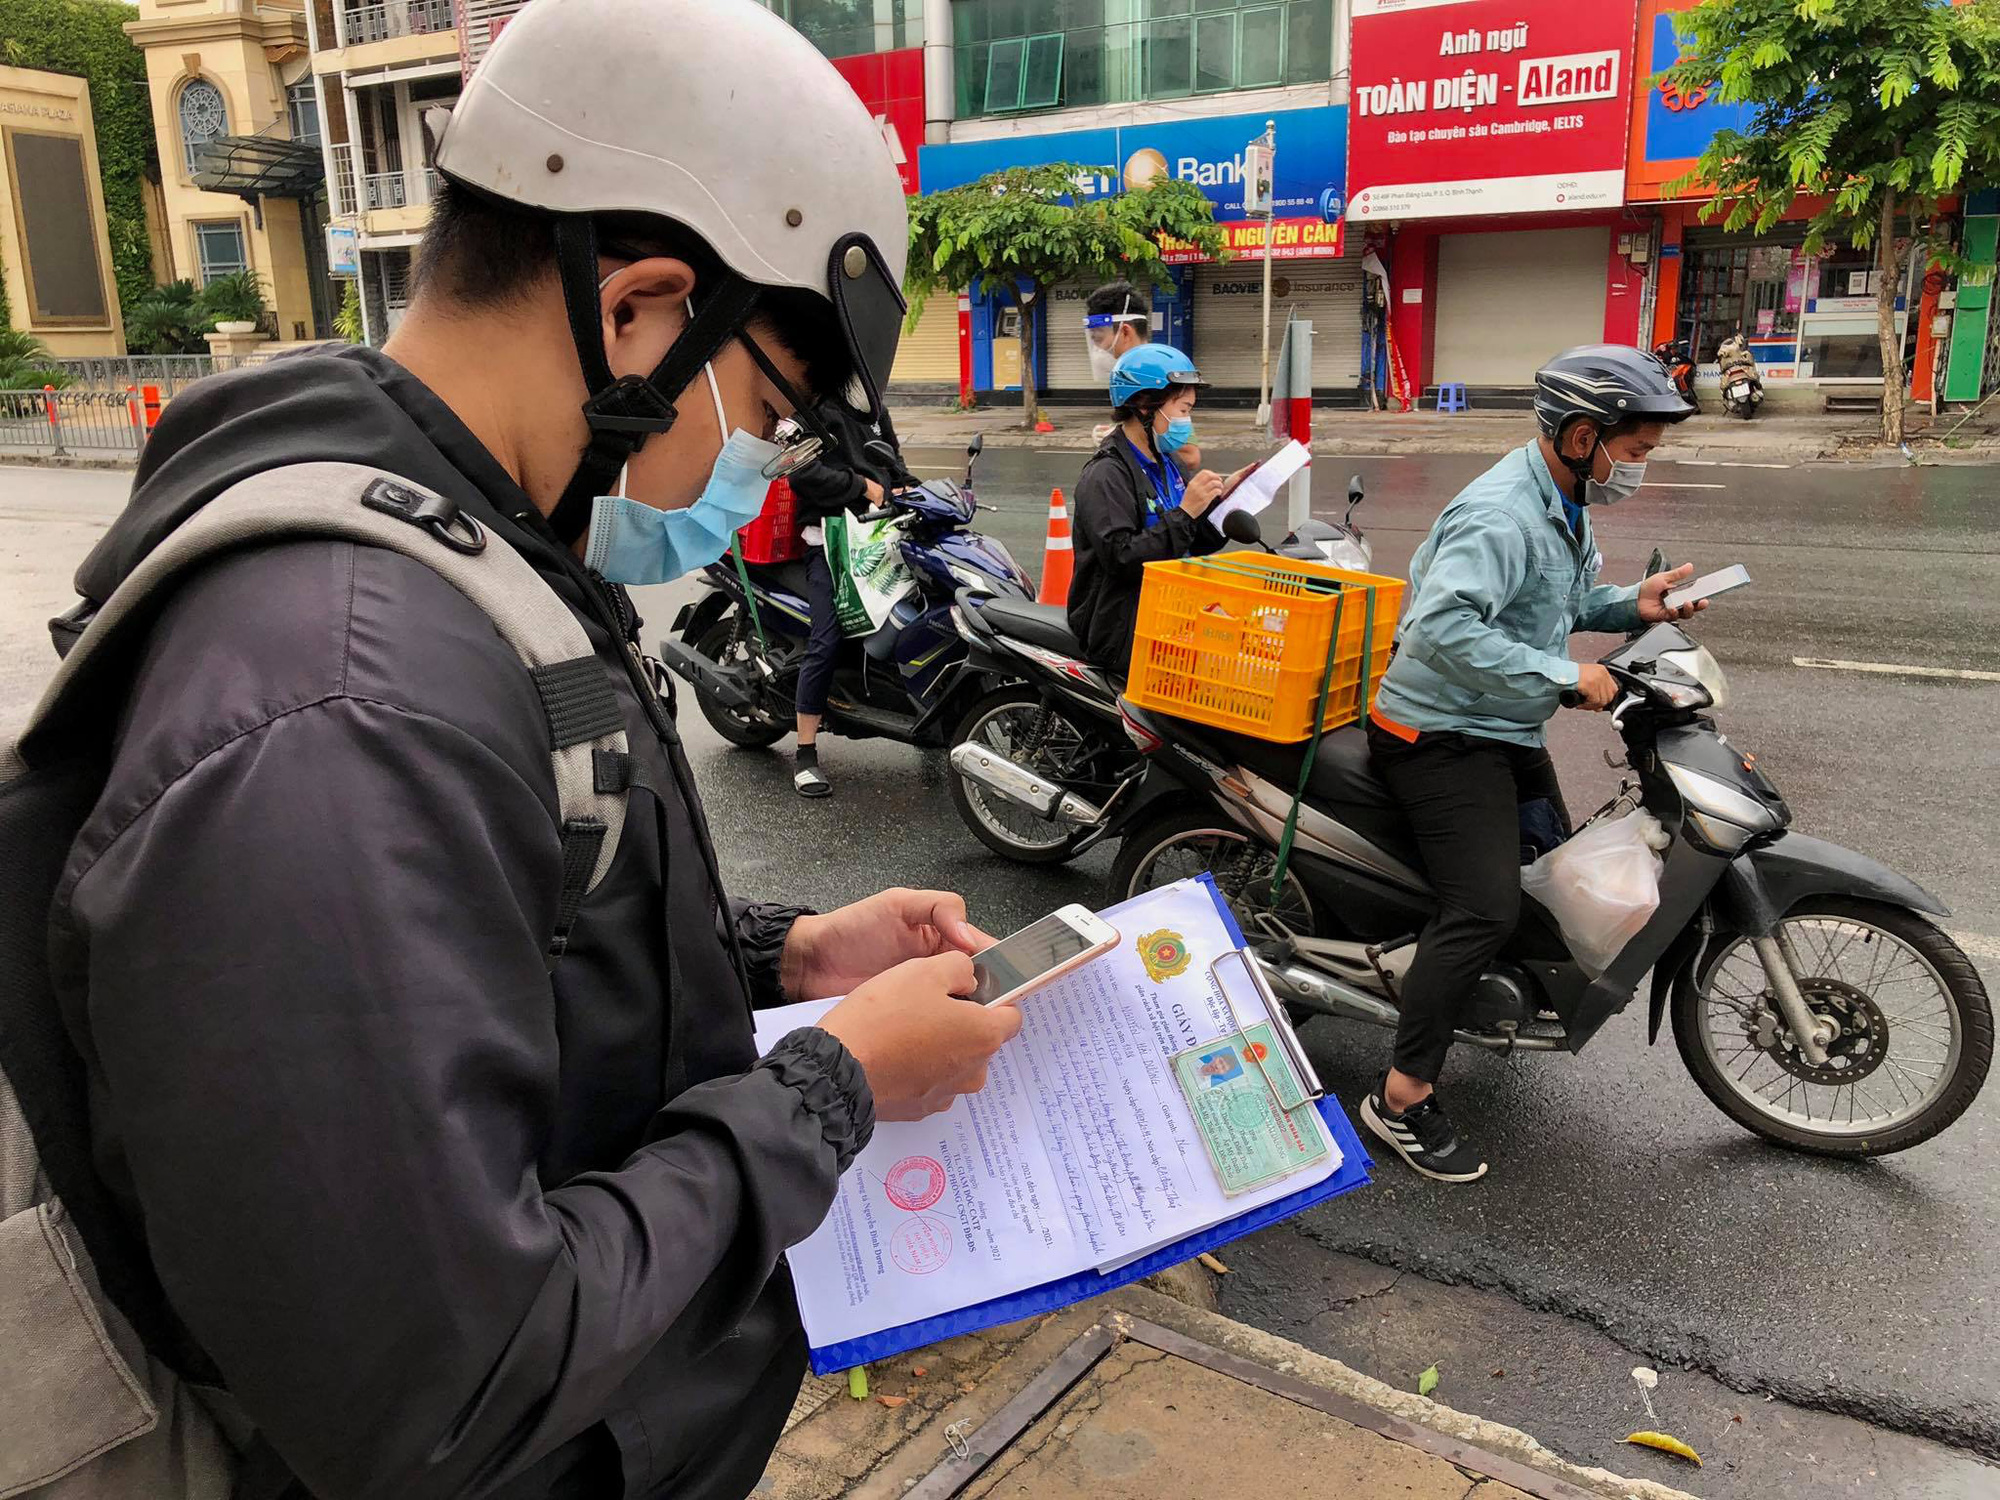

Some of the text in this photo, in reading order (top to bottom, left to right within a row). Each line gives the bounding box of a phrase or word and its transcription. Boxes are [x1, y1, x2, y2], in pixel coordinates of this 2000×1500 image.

[1440, 22, 1528, 56] Anh ngữ
[1356, 77, 1426, 116] TOÀN
[1434, 69, 1498, 112] DIỆN
[1522, 58, 1612, 99] Aland
[41, 107, 73, 120] PLAZA
[1387, 115, 1584, 144] Đào tạo chuyên sâu Cambridge, IELTS
[1178, 154, 1247, 187] Bank
[1234, 224, 1298, 247] NGUYÊN
[1149, 992, 1162, 1009] Tham
[1141, 996, 1154, 1012] cách
[1157, 1030, 1169, 1044] trên
[1156, 1009, 1165, 1020] gia
[1160, 1019, 1172, 1034] giao
[1170, 1001, 1195, 1035] GIẤY
[862, 1202, 876, 1229] Nguyễn
[956, 1203, 968, 1227] CSGT
[962, 1226, 976, 1253] ĐB-ĐS
[968, 1207, 981, 1232] CATP
[869, 1229, 880, 1249] Đình
[873, 1248, 886, 1275] Dương
[990, 1243, 1001, 1263] 2021
